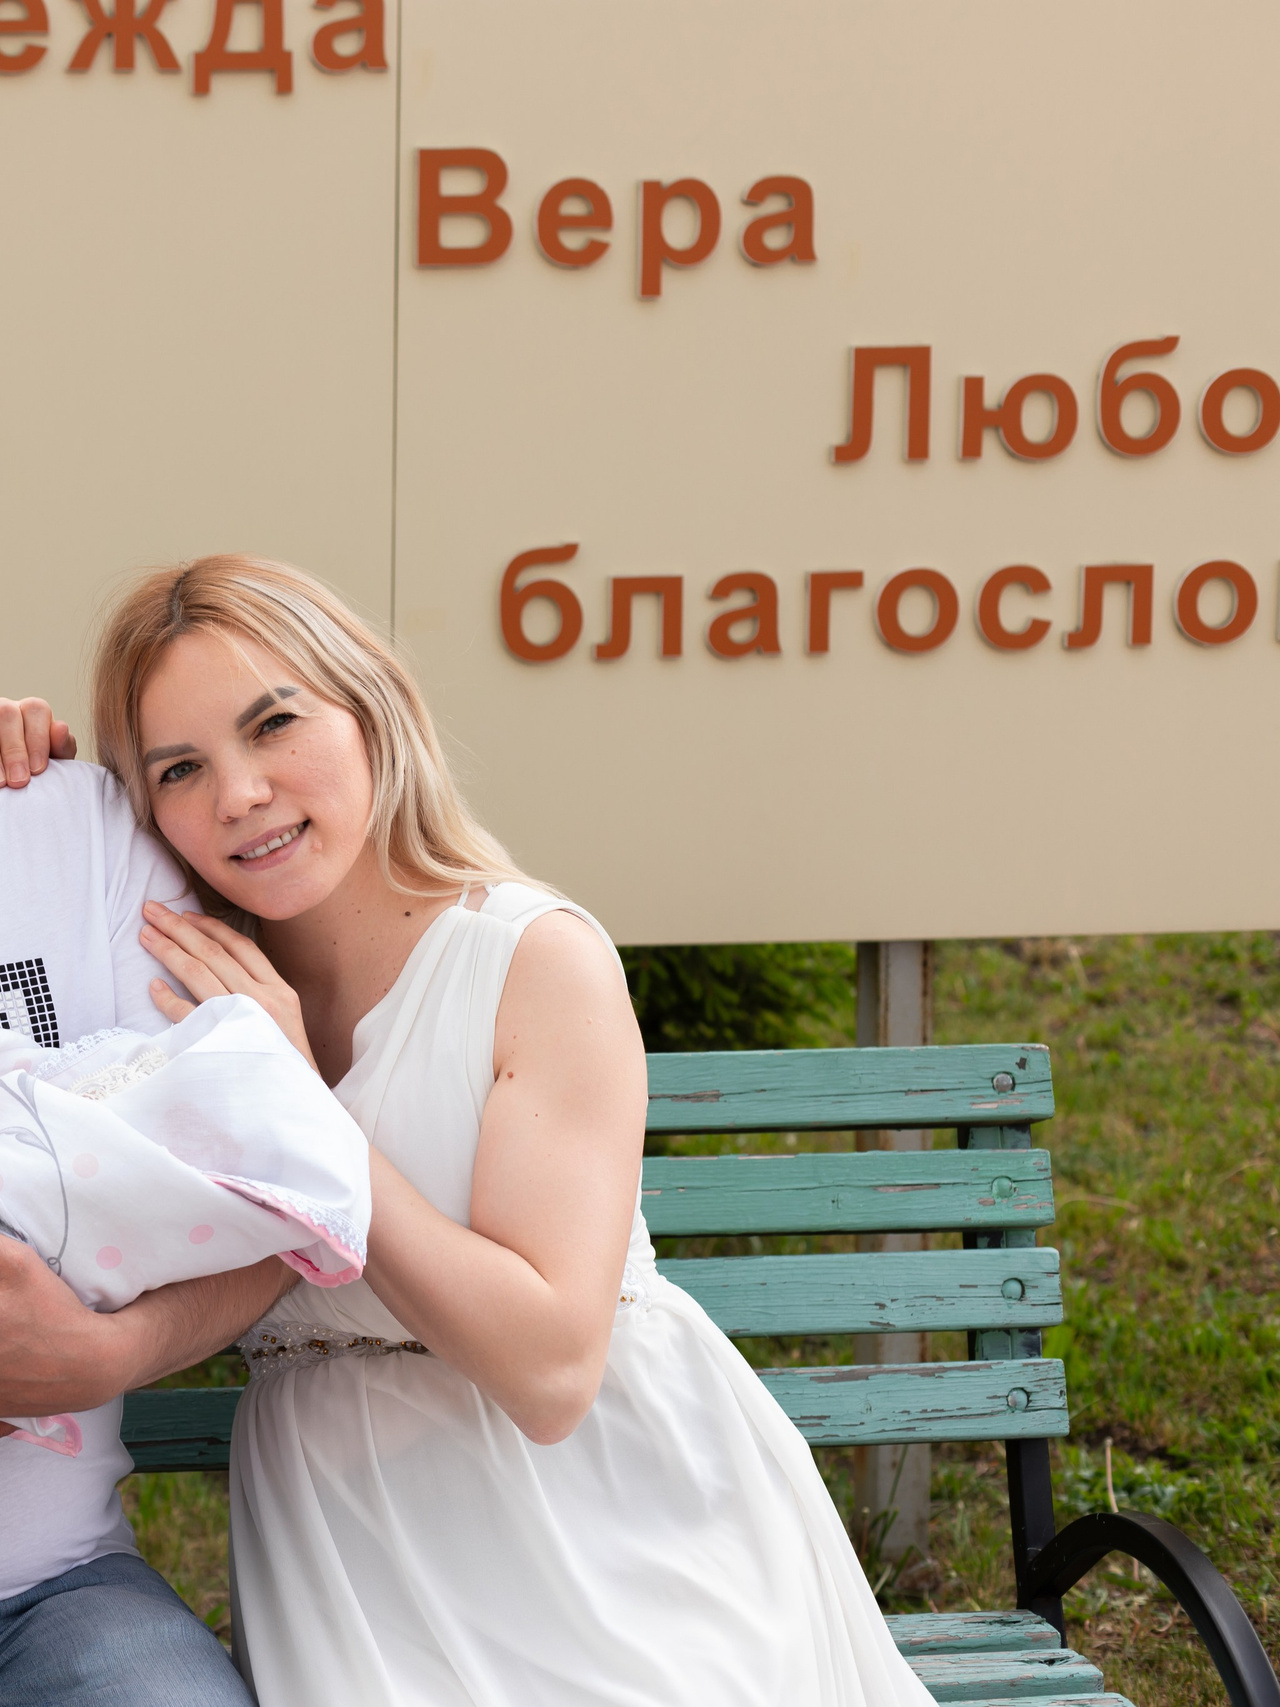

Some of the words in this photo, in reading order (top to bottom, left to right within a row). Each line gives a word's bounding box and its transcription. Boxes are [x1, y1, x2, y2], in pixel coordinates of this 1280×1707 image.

[415, 147, 817, 298] Вера
[832, 335, 1280, 464] Любо
[498, 543, 1280, 663] благосло
